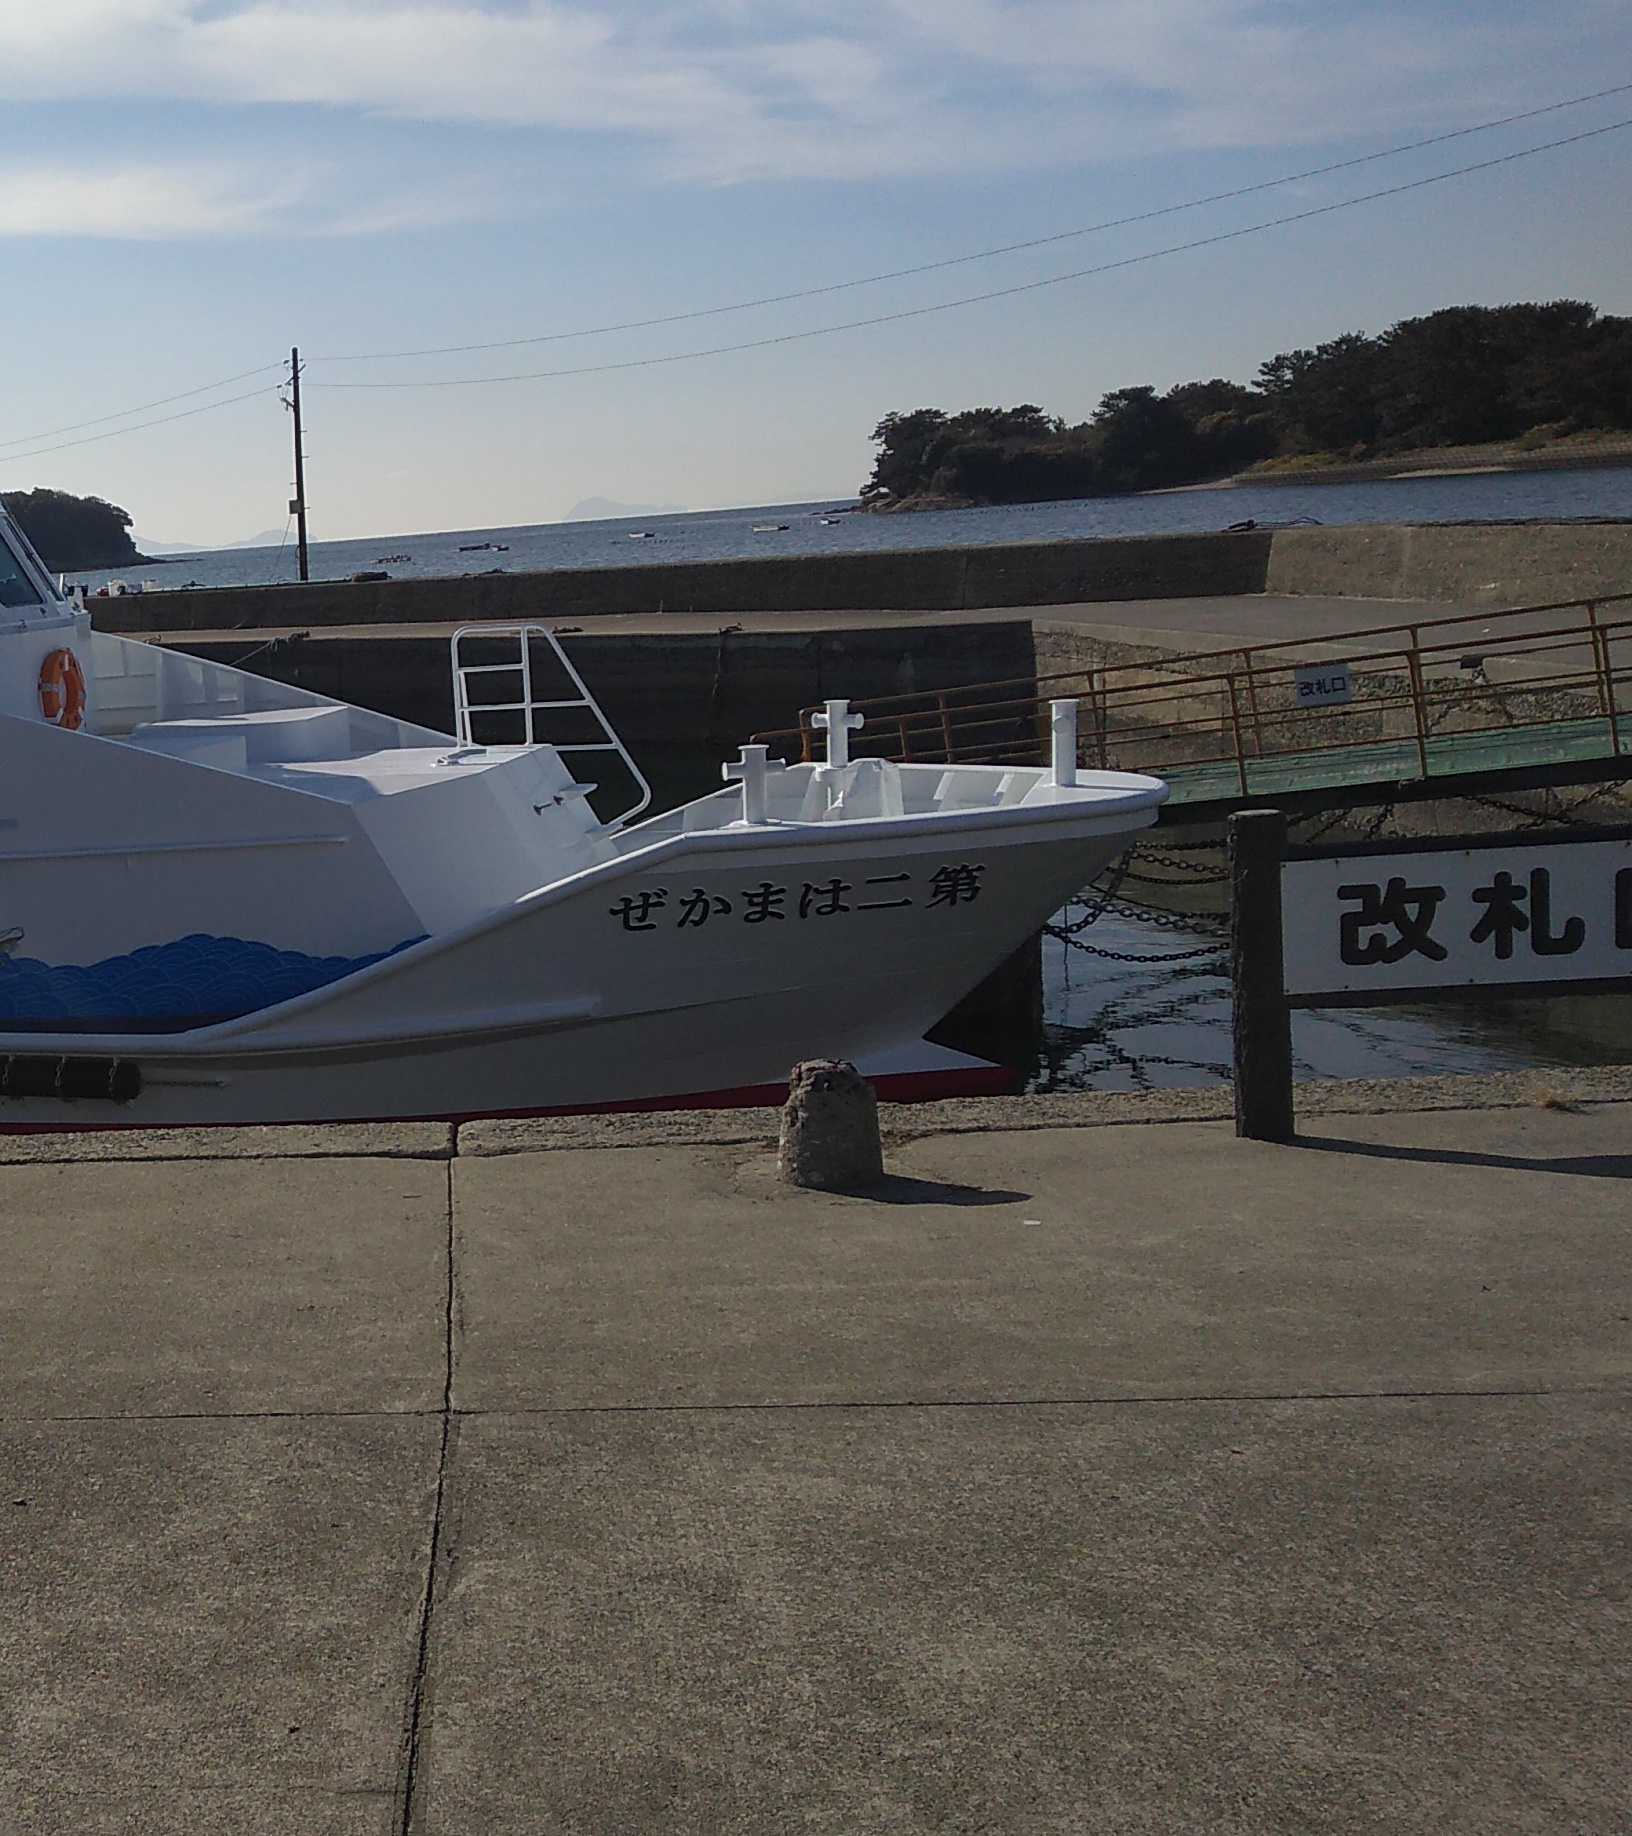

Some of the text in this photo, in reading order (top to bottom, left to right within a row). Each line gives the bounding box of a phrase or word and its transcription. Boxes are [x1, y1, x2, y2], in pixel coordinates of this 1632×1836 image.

[1299, 676, 1347, 697] 改札口
[1336, 866, 1632, 966] 改札
